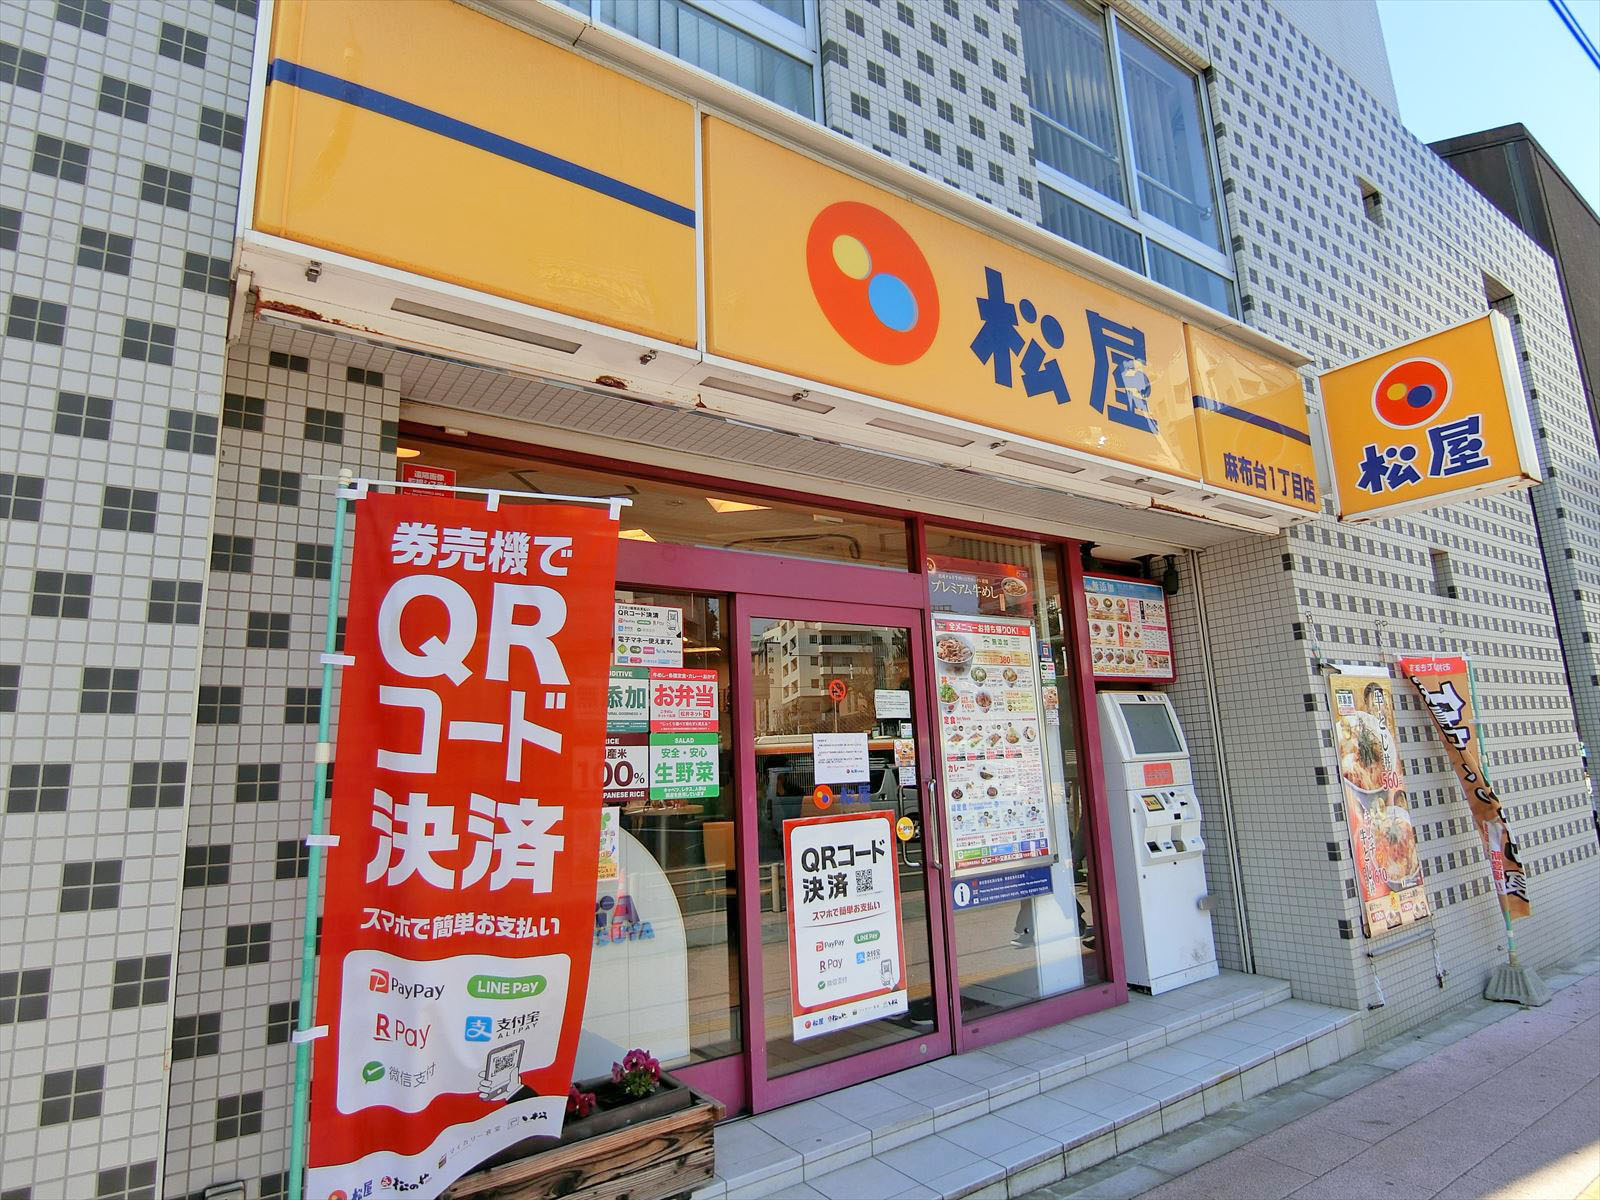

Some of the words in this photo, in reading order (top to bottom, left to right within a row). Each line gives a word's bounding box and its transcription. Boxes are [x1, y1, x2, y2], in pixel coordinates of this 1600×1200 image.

[970, 266, 1159, 434] 松屋
[1355, 413, 1491, 494] 松屋
[1223, 452, 1316, 505] 麻布台1丁目店
[391, 522, 573, 577] 券売機で
[931, 579, 999, 599] プレミアム牛めし
[617, 609, 659, 619] QRコード決済
[377, 574, 570, 686] QR
[617, 635, 674, 646] 電子マネー使えます。
[949, 622, 1019, 635] 全メニューお持ち帰りOK!
[653, 683, 715, 708] お弁当
[376, 684, 567, 783] コード
[661, 747, 708, 759] 安全・安心
[654, 761, 715, 784] 生野菜
[948, 764, 965, 773] カレー
[629, 790, 645, 798] RICE
[365, 788, 565, 894] 決済
[801, 839, 885, 873] QRコード
[802, 872, 849, 904] 決済
[812, 901, 881, 921] スマホで簡単お支払い
[360, 907, 560, 940] スマホで簡単お支払い
[824, 939, 845, 949] PayPay
[827, 958, 843, 968] Pay
[391, 976, 445, 1001] PayPay
[477, 980, 510, 994] LINE
[512, 979, 540, 994] Pay
[496, 1011, 541, 1033] 支付宝
[497, 1021, 539, 1040] ALIPAY
[395, 1020, 432, 1050] Pay
[388, 1061, 437, 1088] 微信支付
